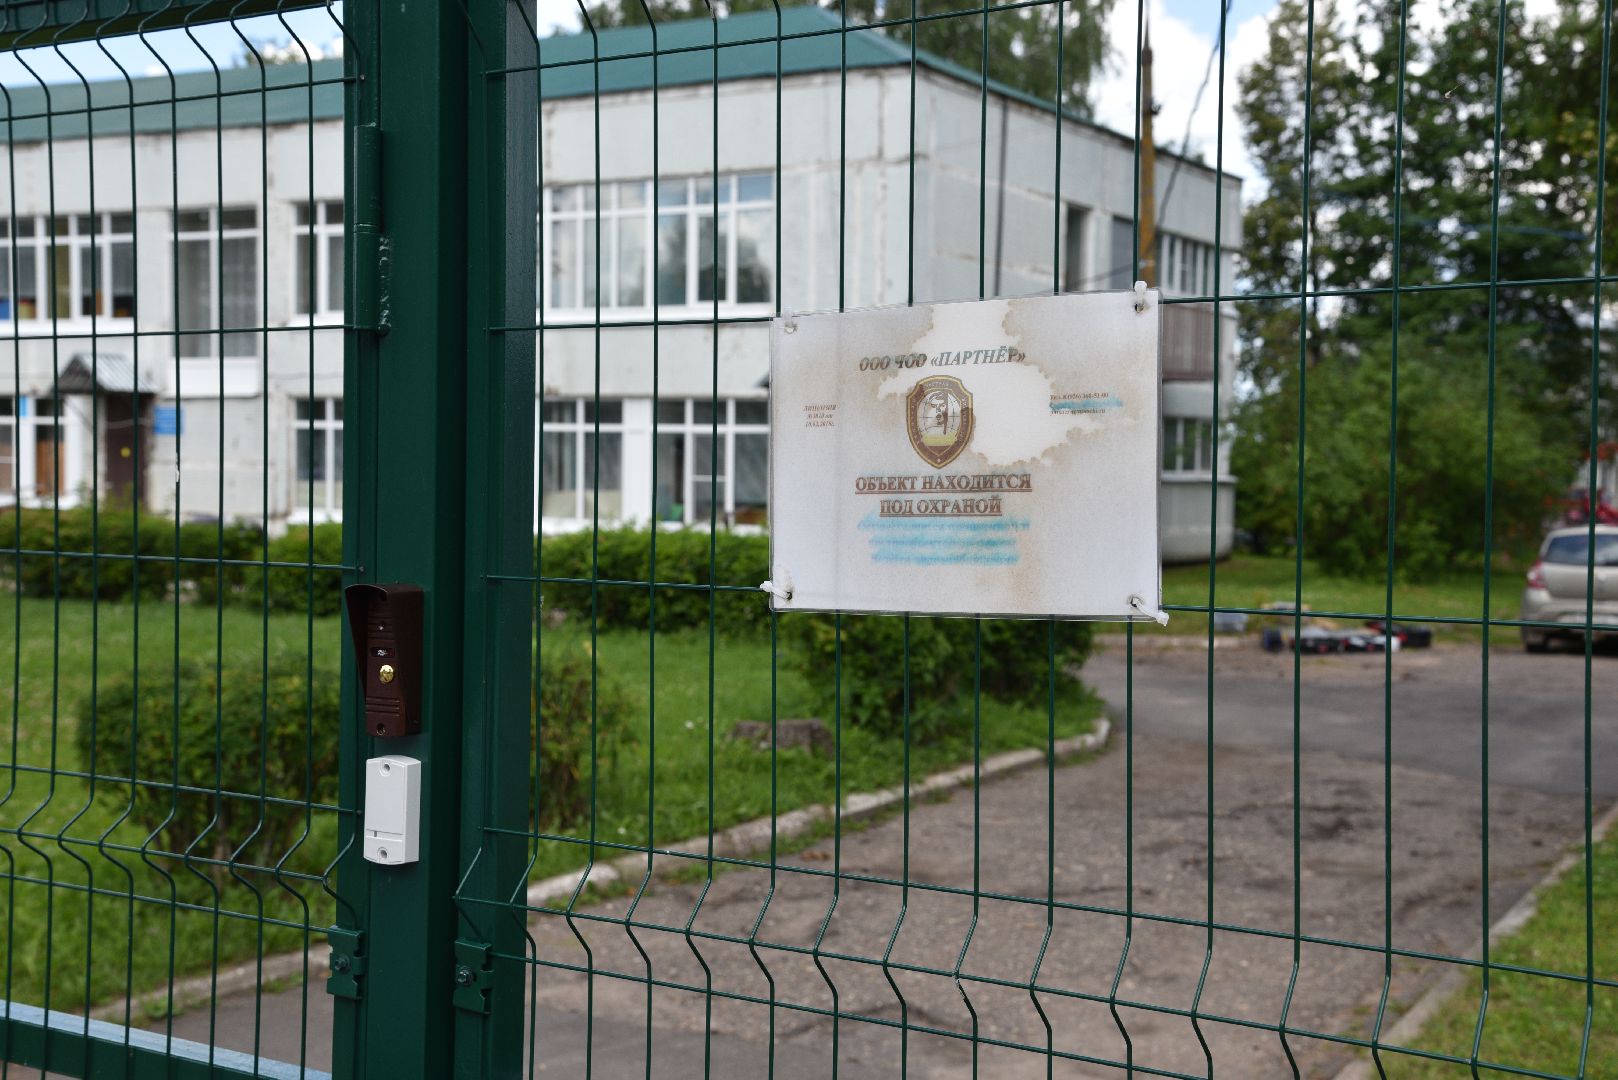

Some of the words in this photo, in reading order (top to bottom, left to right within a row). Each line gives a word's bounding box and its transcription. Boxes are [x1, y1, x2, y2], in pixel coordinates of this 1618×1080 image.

[859, 355, 891, 371] ООО
[894, 353, 928, 369] ЧОО
[931, 346, 1026, 367] «ПАРТНЁР»
[855, 476, 917, 491] ОБЪЕКТ
[921, 474, 1031, 491] НАХОДИТСЯ
[879, 500, 914, 514] ПОД
[916, 495, 1003, 514] ОХРАНОЙ
